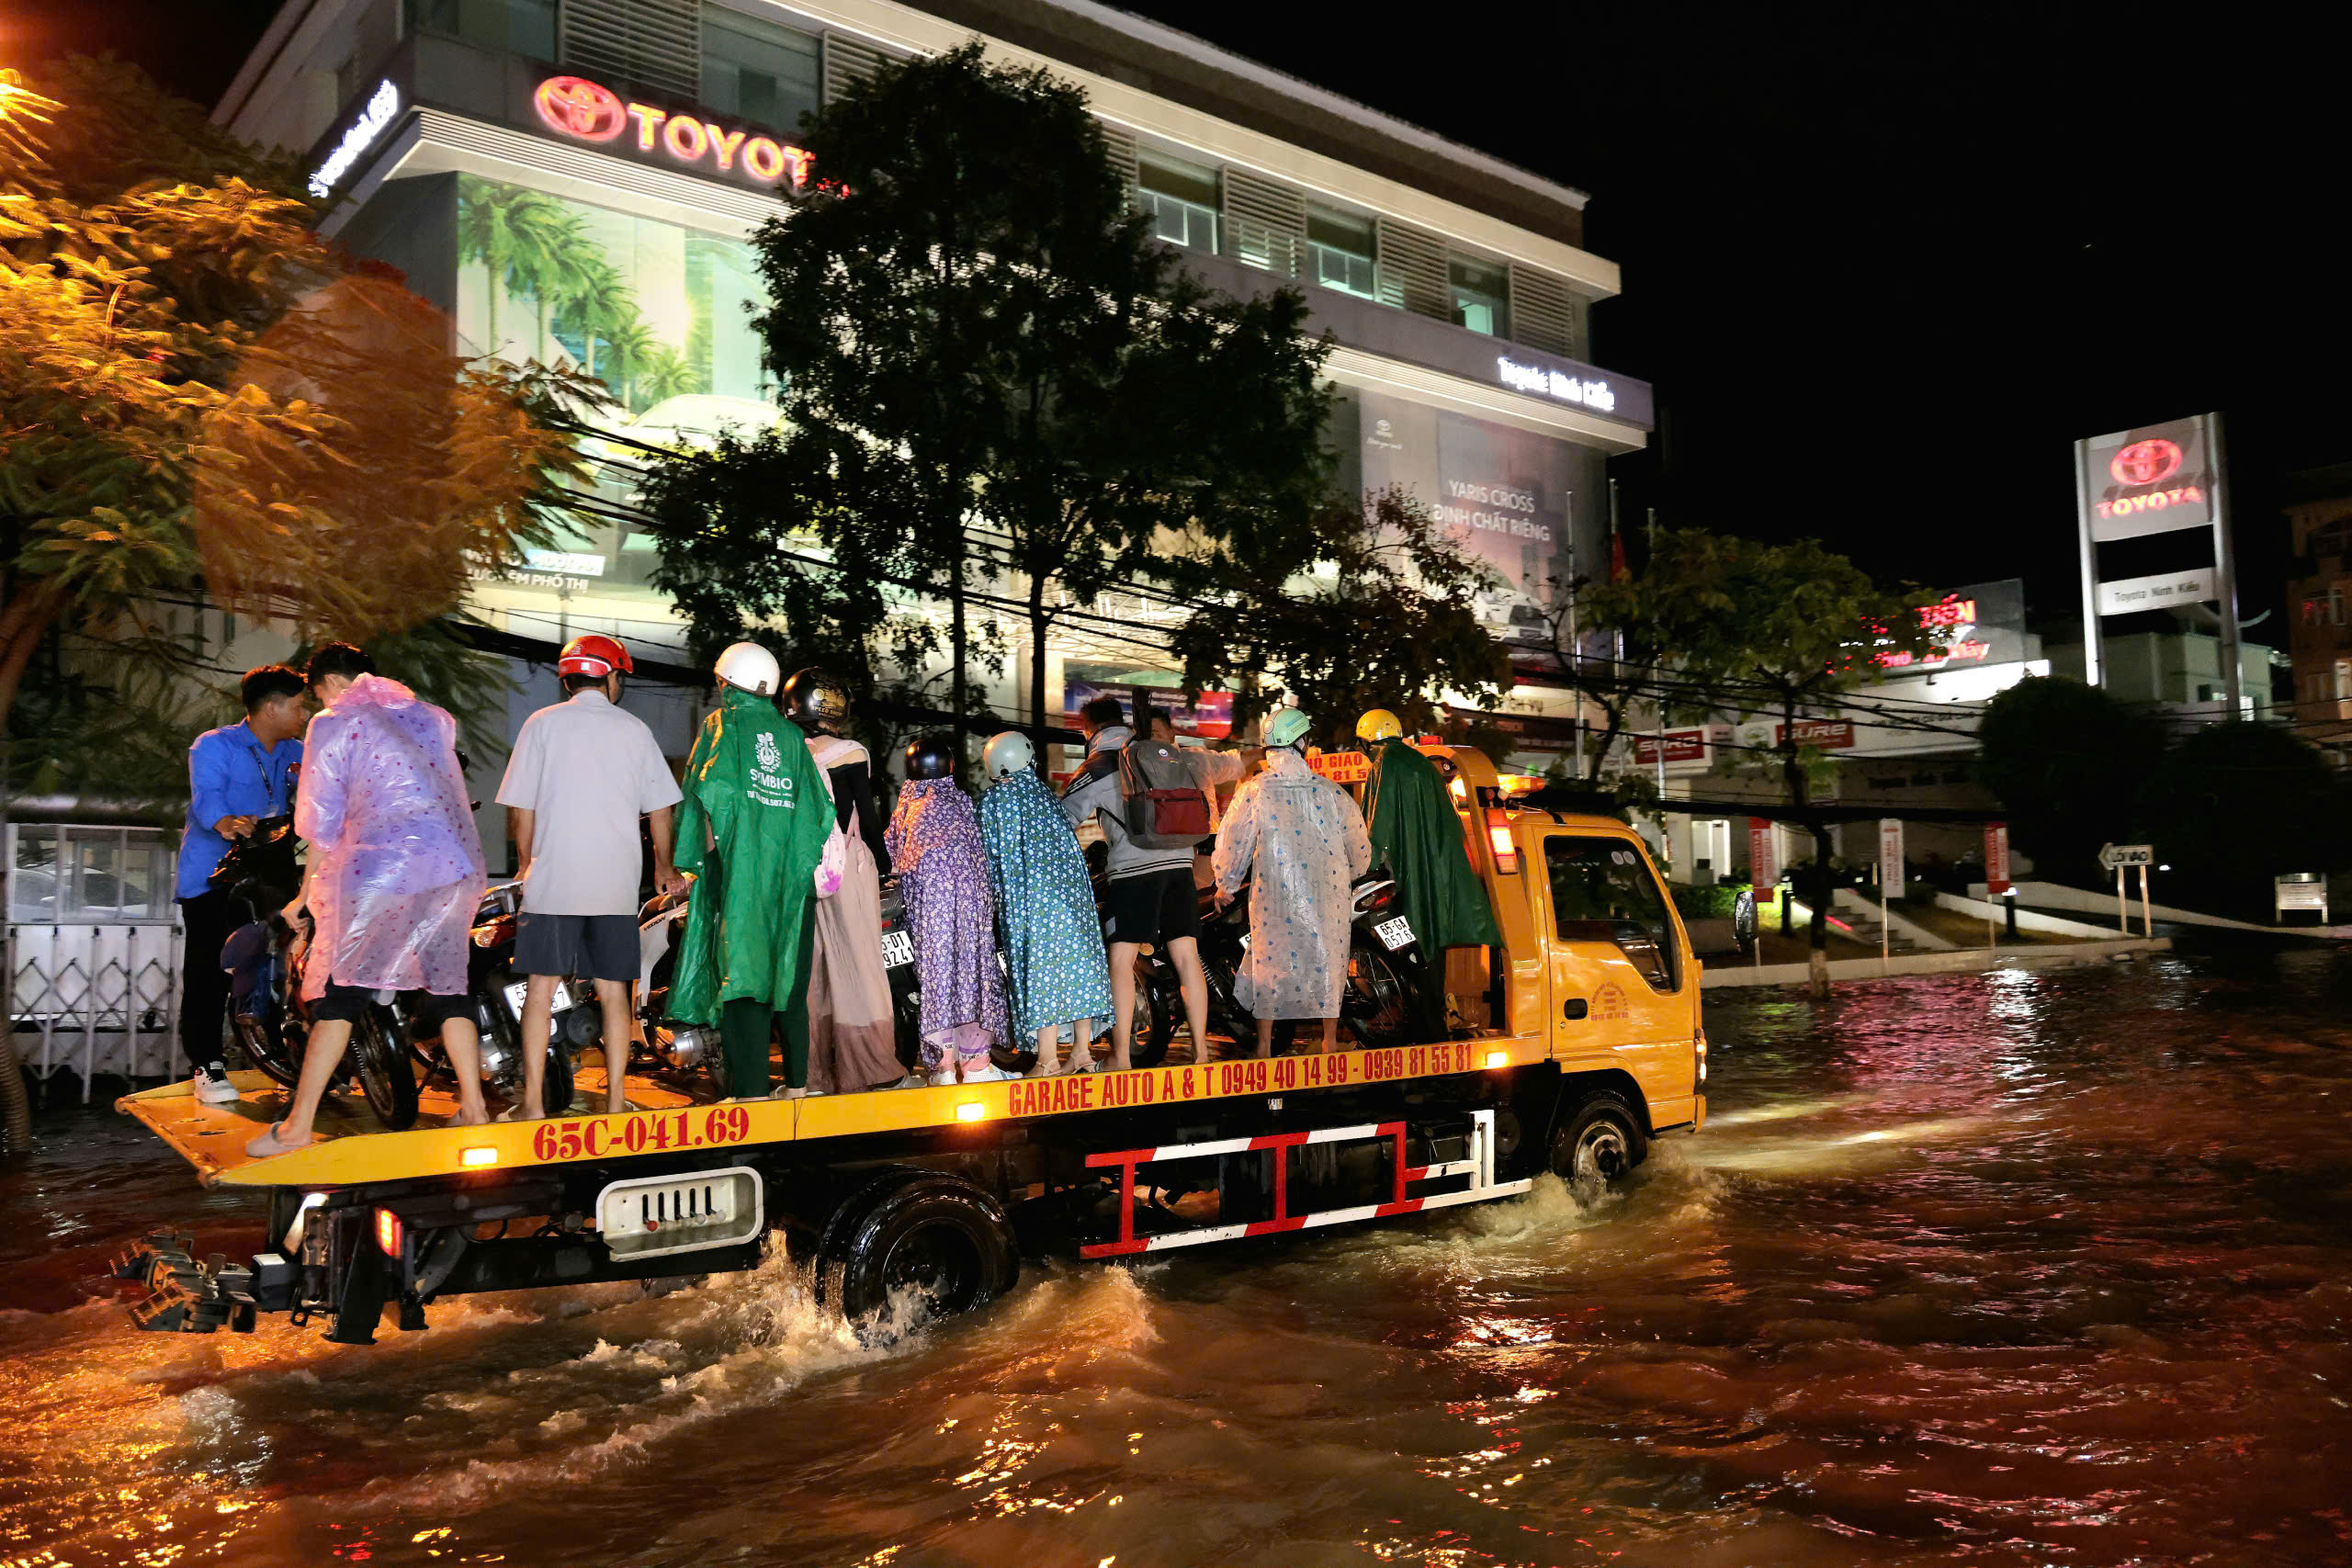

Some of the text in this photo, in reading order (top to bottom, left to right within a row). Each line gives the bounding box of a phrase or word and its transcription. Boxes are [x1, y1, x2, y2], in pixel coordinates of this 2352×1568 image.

[1449, 480, 1535, 513] YARIS CROSS
[2096, 486, 2202, 518] TOYOTA
[1329, 753, 1363, 768] GIAO
[1332, 770, 1351, 781] 81
[1009, 1077, 1093, 1116] GARAGE
[1102, 1072, 1154, 1107] AUTO
[1161, 1070, 1175, 1101] A
[1182, 1067, 1195, 1099] &
[1204, 1066, 1214, 1096] T
[1221, 1061, 1267, 1095] 0949
[1273, 1058, 1296, 1089] 40
[1302, 1056, 1322, 1087] 14
[1327, 1054, 1348, 1085] 99
[1363, 1048, 1404, 1081] 0939
[1408, 1047, 1426, 1077] 81
[1429, 1044, 1451, 1075] 55
[1454, 1043, 1472, 1072] 81
[533, 1106, 750, 1161] 65C-041.69
